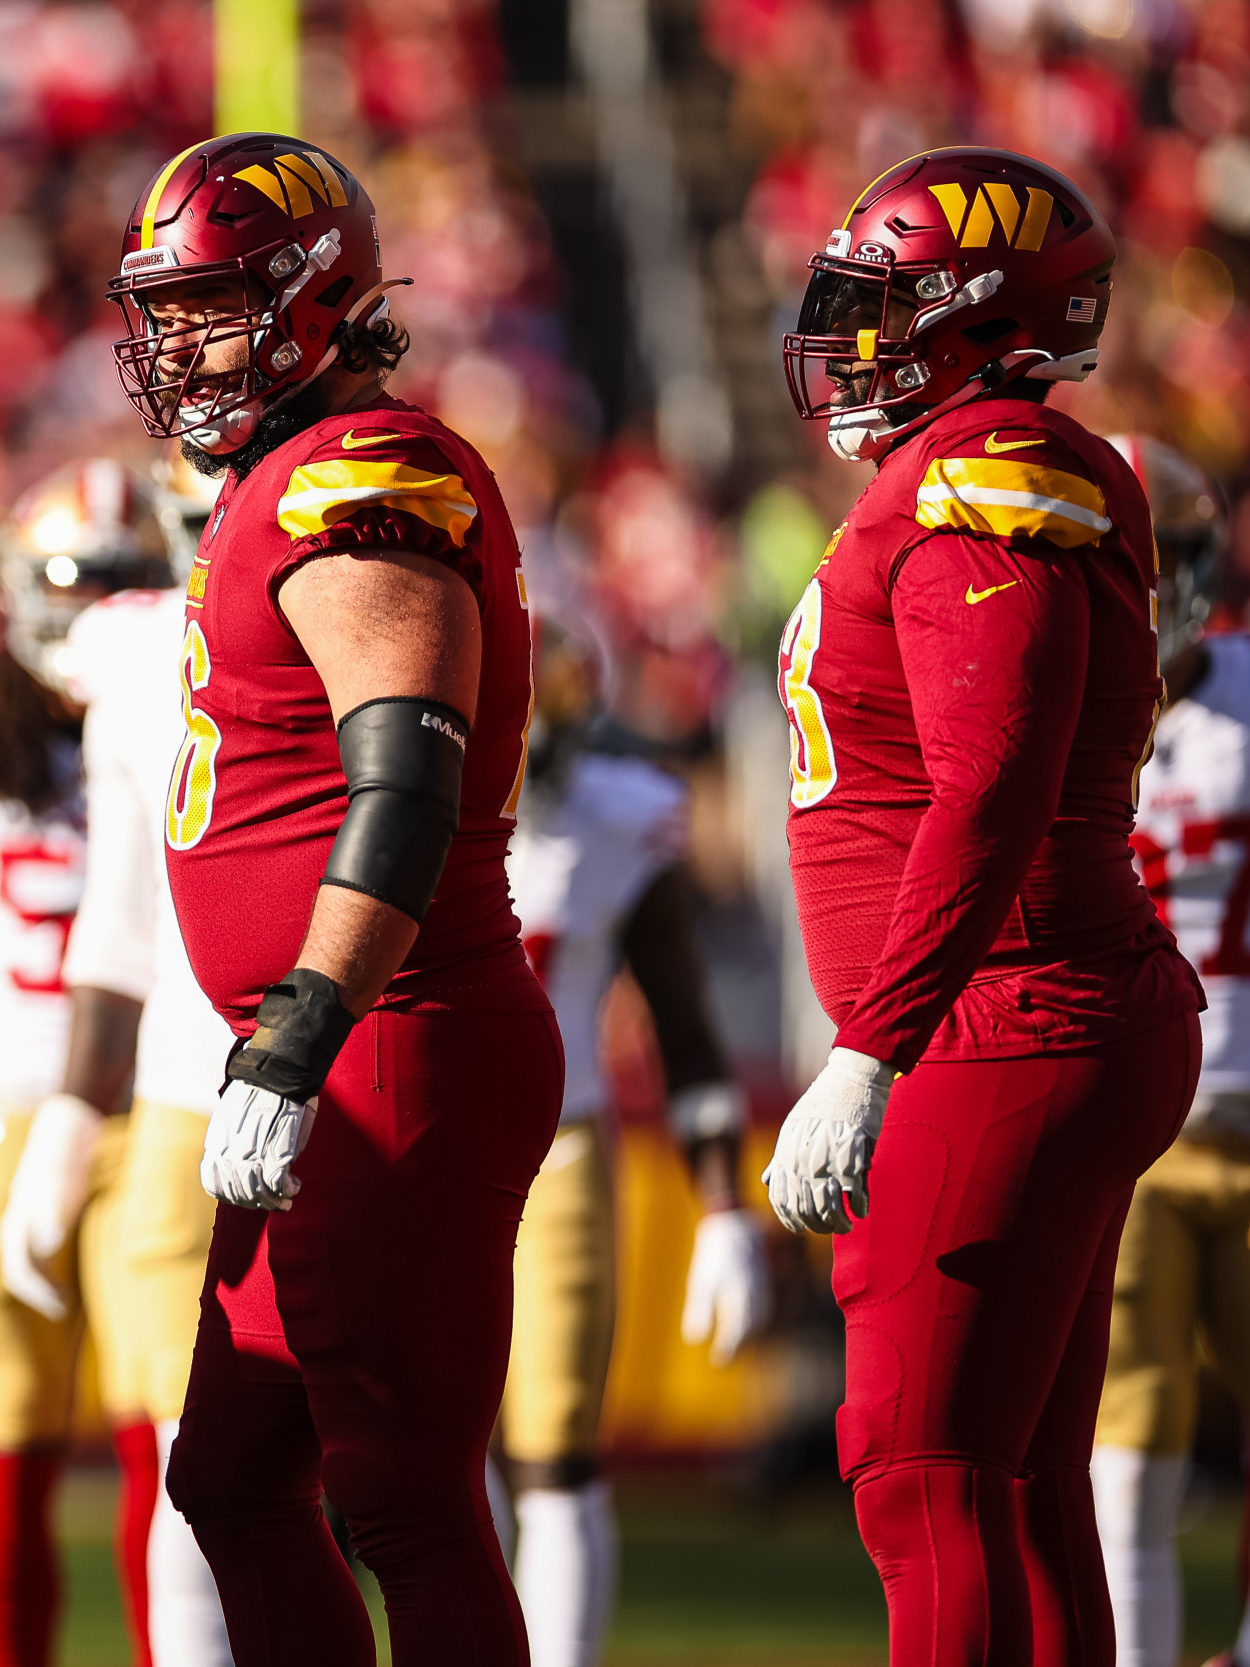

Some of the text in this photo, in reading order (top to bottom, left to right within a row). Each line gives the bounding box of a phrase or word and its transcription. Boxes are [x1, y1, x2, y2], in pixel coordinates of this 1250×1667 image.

[854, 252, 890, 264] OAKLEY
[164, 618, 223, 851] 6
[433, 715, 466, 754] Muel
[777, 576, 839, 809] 3
